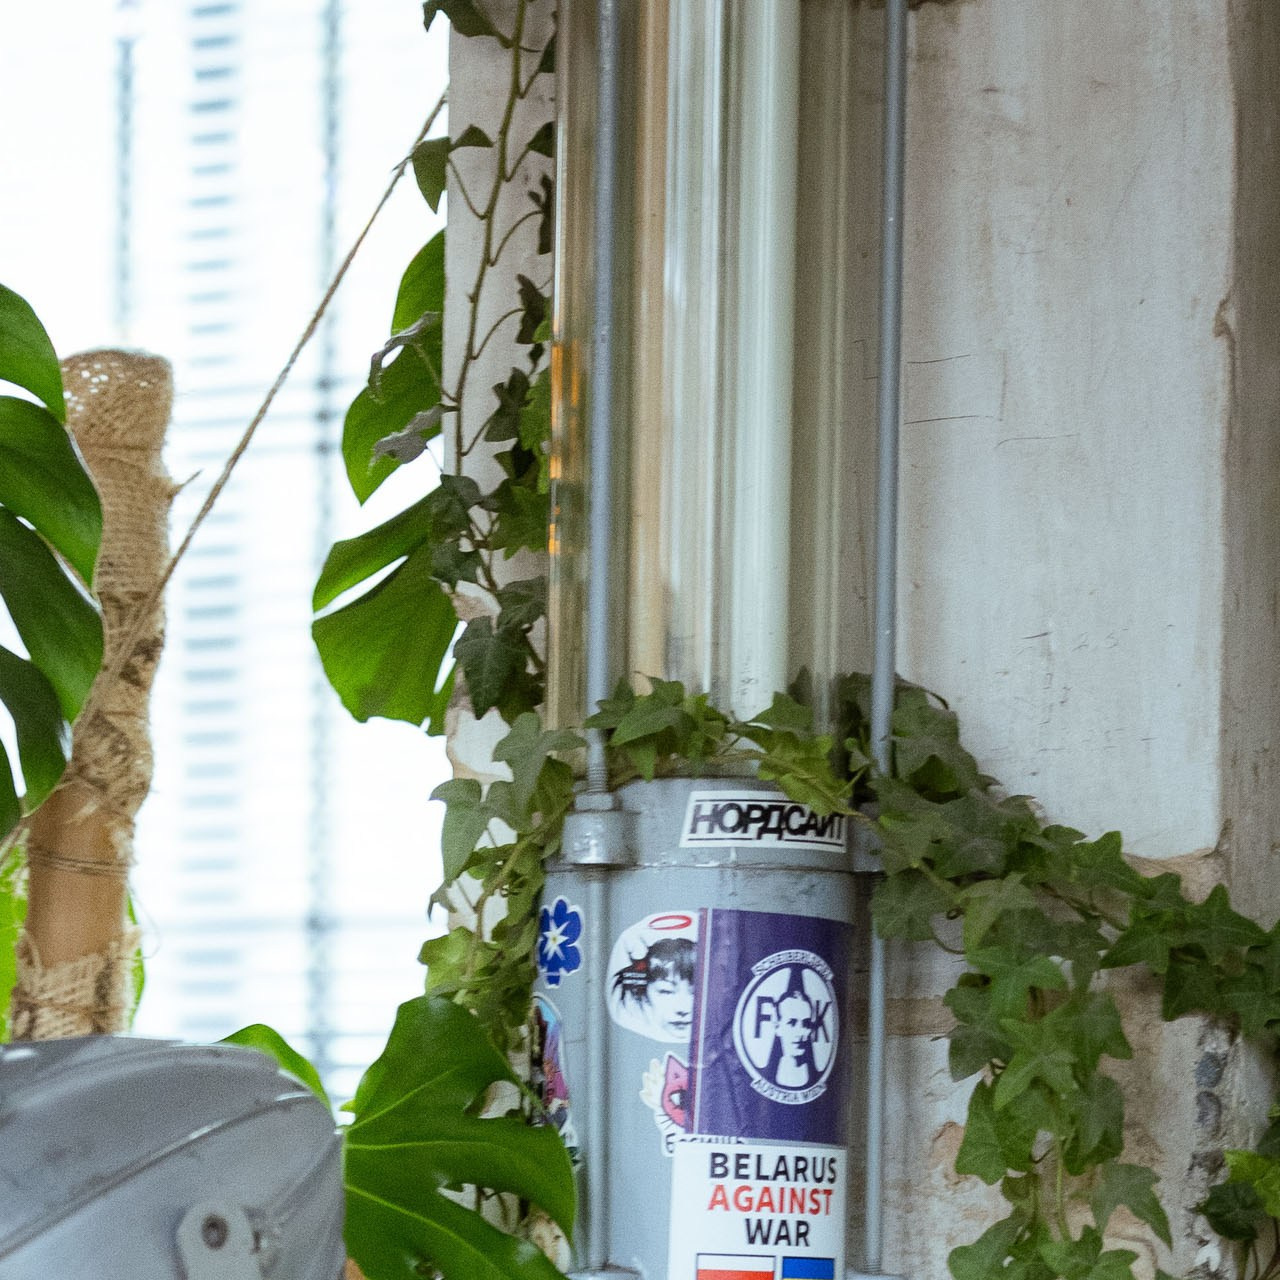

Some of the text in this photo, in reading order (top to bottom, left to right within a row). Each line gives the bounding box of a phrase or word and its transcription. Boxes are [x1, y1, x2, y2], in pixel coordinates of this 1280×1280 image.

[709, 1152, 837, 1184] BELARUS
[708, 1184, 834, 1215] AGAINST
[744, 1218, 810, 1247] WAR
